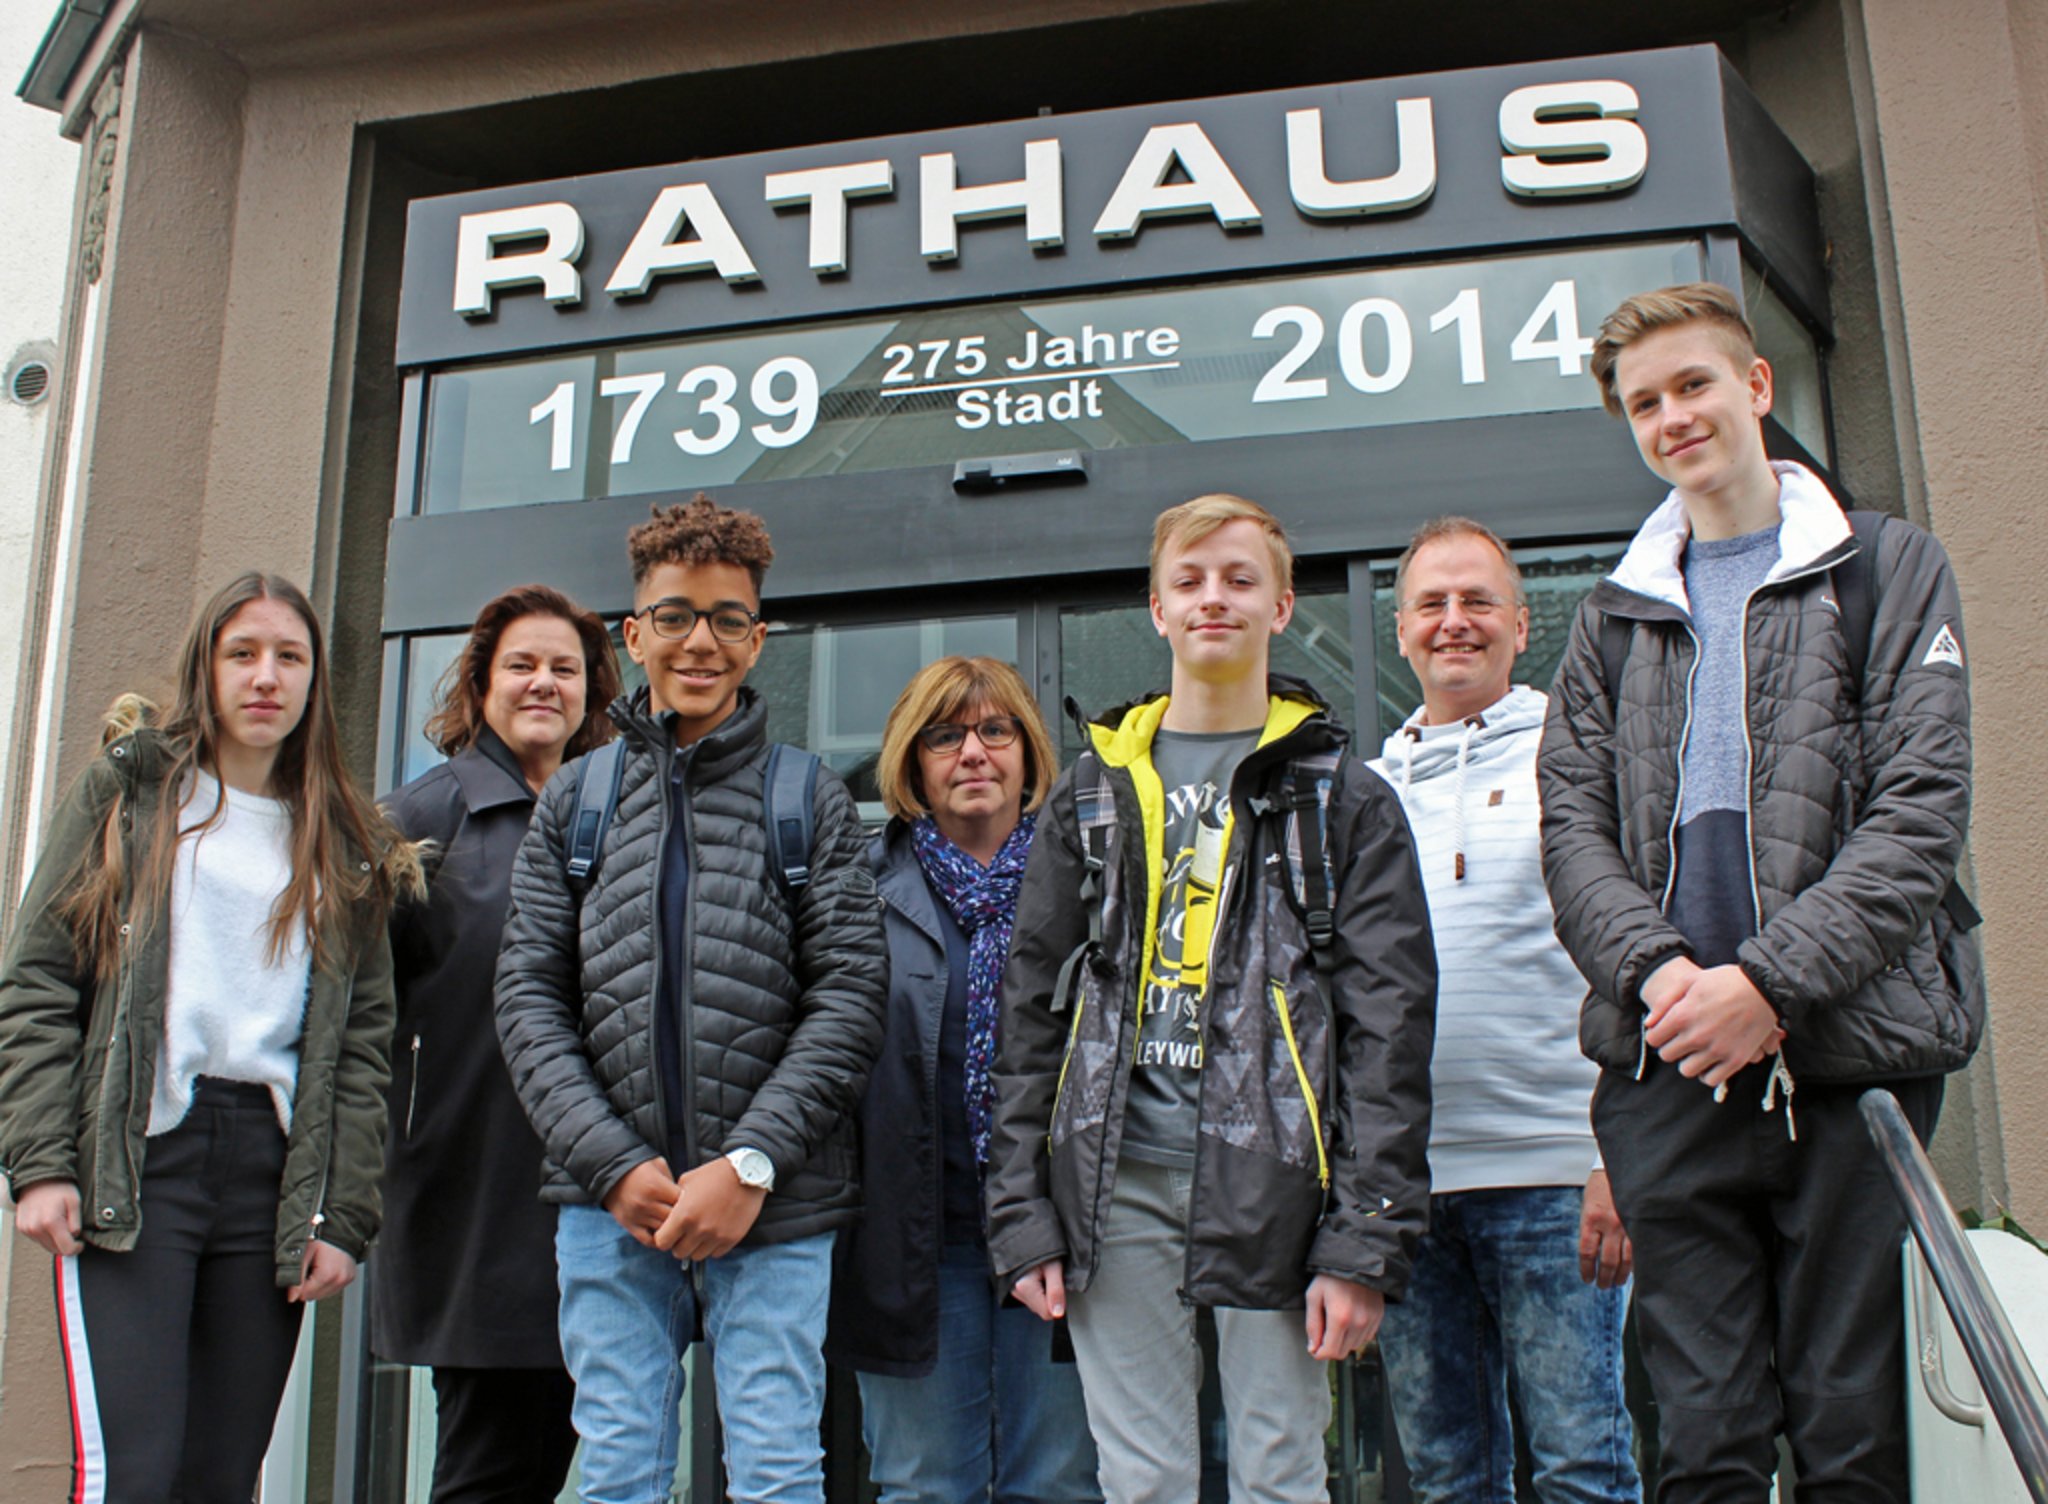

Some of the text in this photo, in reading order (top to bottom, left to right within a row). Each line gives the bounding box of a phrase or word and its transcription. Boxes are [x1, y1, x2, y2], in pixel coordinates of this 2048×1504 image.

[453, 79, 1649, 319] RATHAUS
[529, 279, 1597, 472] 1739 2014
[881, 325, 1180, 384] 275 Jahre
[955, 379, 1103, 429] Stadt
